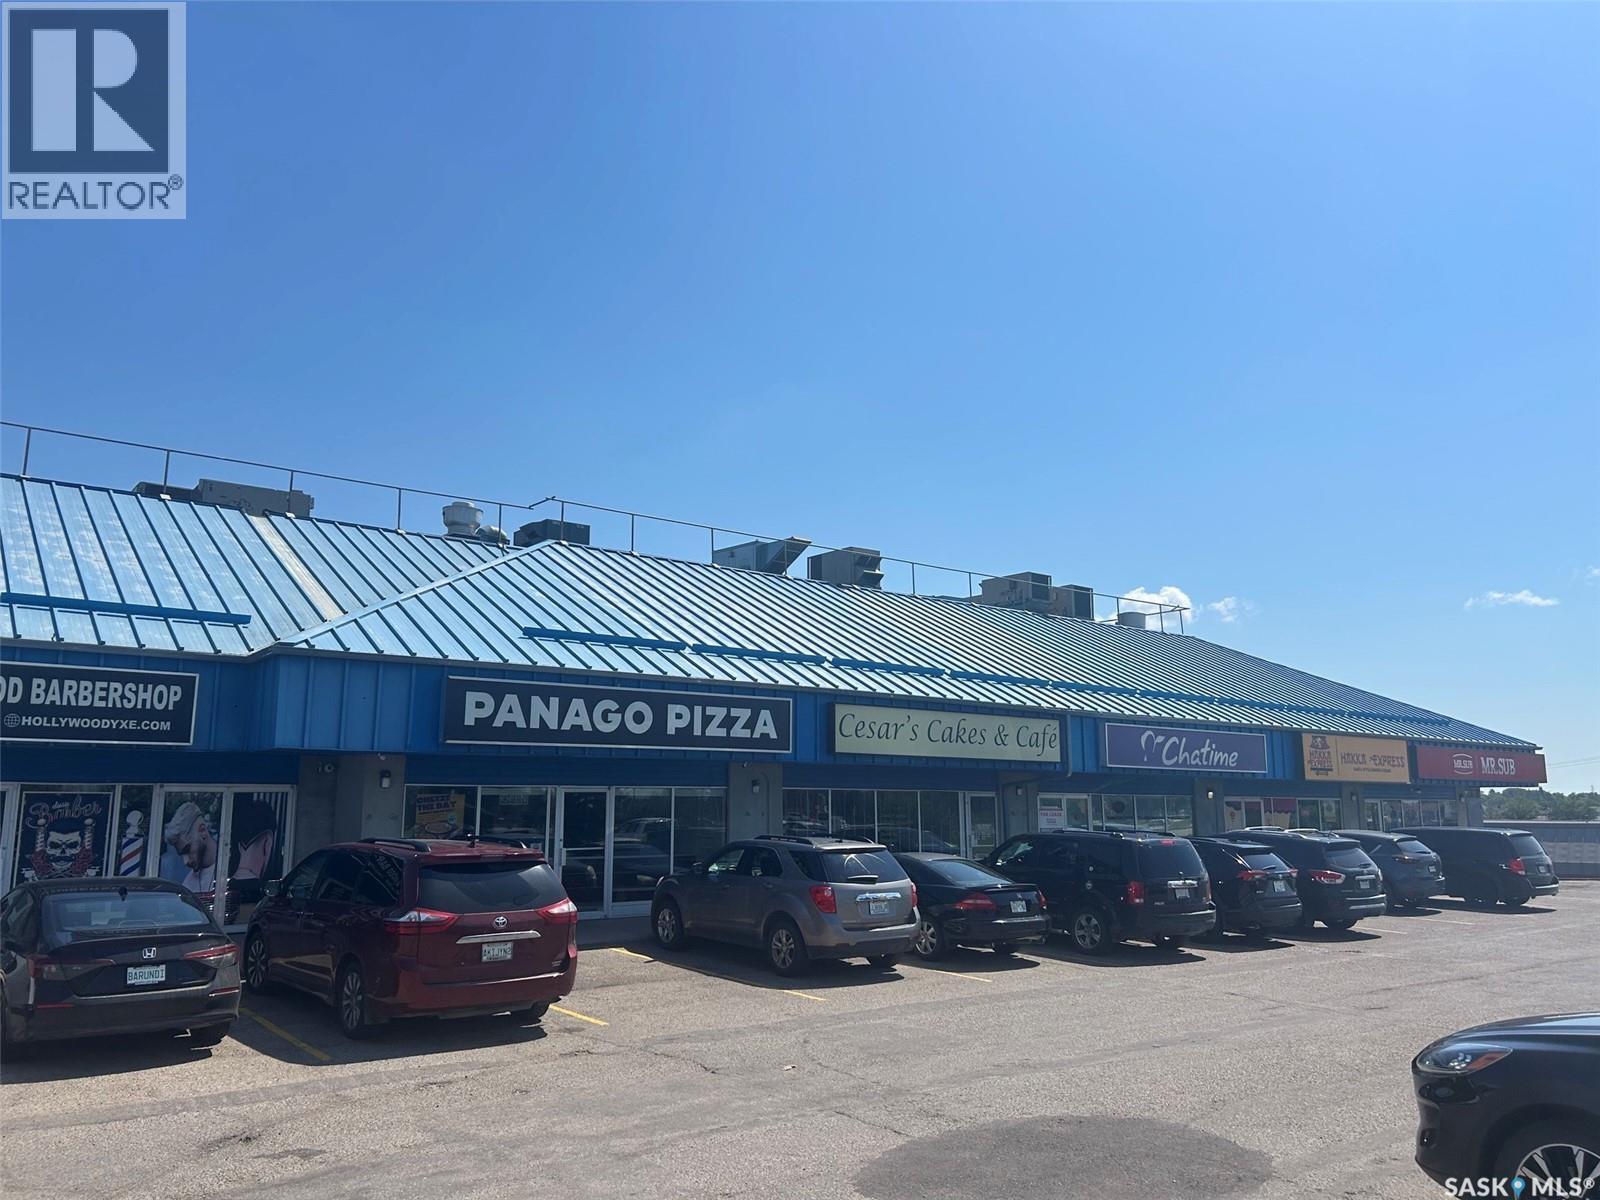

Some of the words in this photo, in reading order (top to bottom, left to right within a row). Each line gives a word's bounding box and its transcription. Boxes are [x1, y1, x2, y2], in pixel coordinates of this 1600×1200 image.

[30, 678, 182, 710] BARBERSHOP
[21, 716, 171, 731] HOLLYWOODYXE.COM
[463, 690, 653, 735] PANAGO
[666, 704, 778, 740] PIZZA
[838, 713, 919, 741] Cesar's
[927, 718, 987, 746] Cakes
[994, 724, 1009, 747] &
[1016, 724, 1058, 757] Café
[1161, 736, 1239, 767] Chatime
[1340, 752, 1367, 765] HAKKA
[1369, 754, 1405, 768] EXPRESS
[128, 968, 165, 981] BARUNDI
